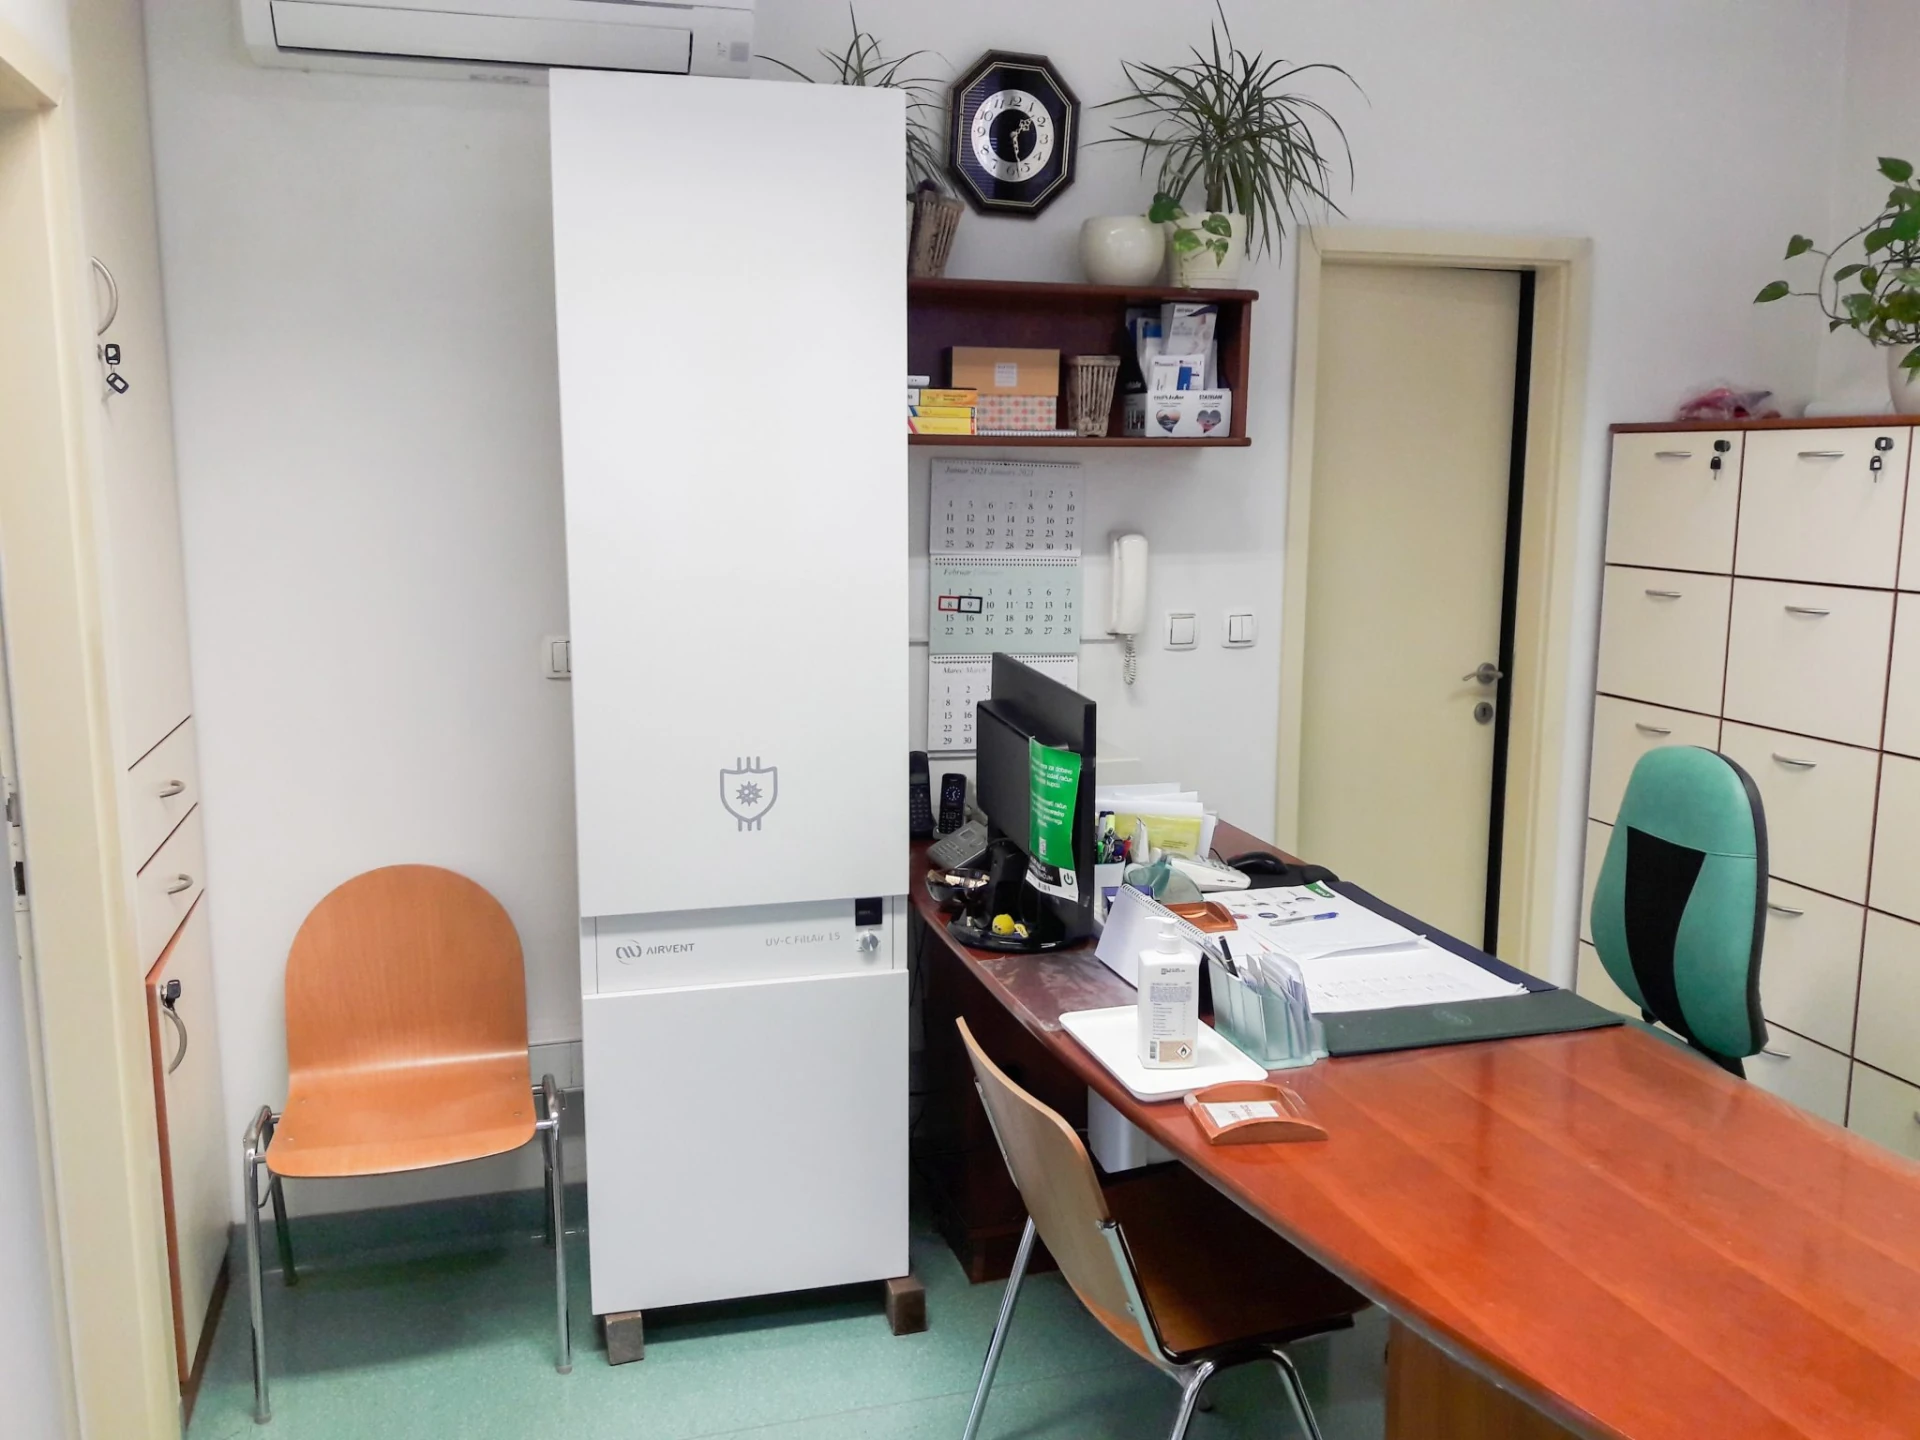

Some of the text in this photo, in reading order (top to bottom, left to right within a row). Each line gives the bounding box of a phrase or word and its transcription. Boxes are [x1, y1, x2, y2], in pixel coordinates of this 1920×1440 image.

[994, 99, 1004, 109] 11
[1009, 96, 1022, 108] 12
[1029, 102, 1034, 112] 1
[980, 110, 993, 121] 10
[1037, 116, 1046, 127] 2
[977, 126, 986, 137] 9
[1039, 134, 1049, 144] 3
[980, 144, 989, 155] 8
[992, 157, 998, 169] 7
[1021, 162, 1030, 173] 5
[1006, 165, 1015, 176] 6
[1067, 504, 1075, 512] 10
[947, 513, 954, 521] 11
[967, 514, 975, 522] 12
[1007, 515, 1015, 523] 14
[1027, 516, 1035, 524] 15
[1066, 517, 1074, 525] 17
[946, 526, 1073, 538] 18 19 20 21 22 23 24
[945, 540, 954, 548] 25
[985, 541, 994, 549] 27
[1005, 541, 1014, 550] 28
[1025, 542, 1034, 550] 29
[1065, 543, 1072, 551] 31
[986, 601, 995, 609] 10
[1006, 601, 1013, 609] 11
[1026, 601, 1033, 609] 12
[1045, 601, 1053, 609] 13
[946, 614, 954, 622] 15
[966, 614, 974, 622] 16
[986, 614, 994, 622] 17
[1044, 614, 1053, 622] 20
[1064, 614, 1071, 622] 21
[945, 627, 1072, 635] 22 23 24 25 26 27 28
[943, 724, 972, 732] 22 23
[943, 737, 952, 745] 29
[766, 935, 792, 946] UV-C
[828, 931, 841, 941] 15
[646, 943, 695, 955] AIRVENT
